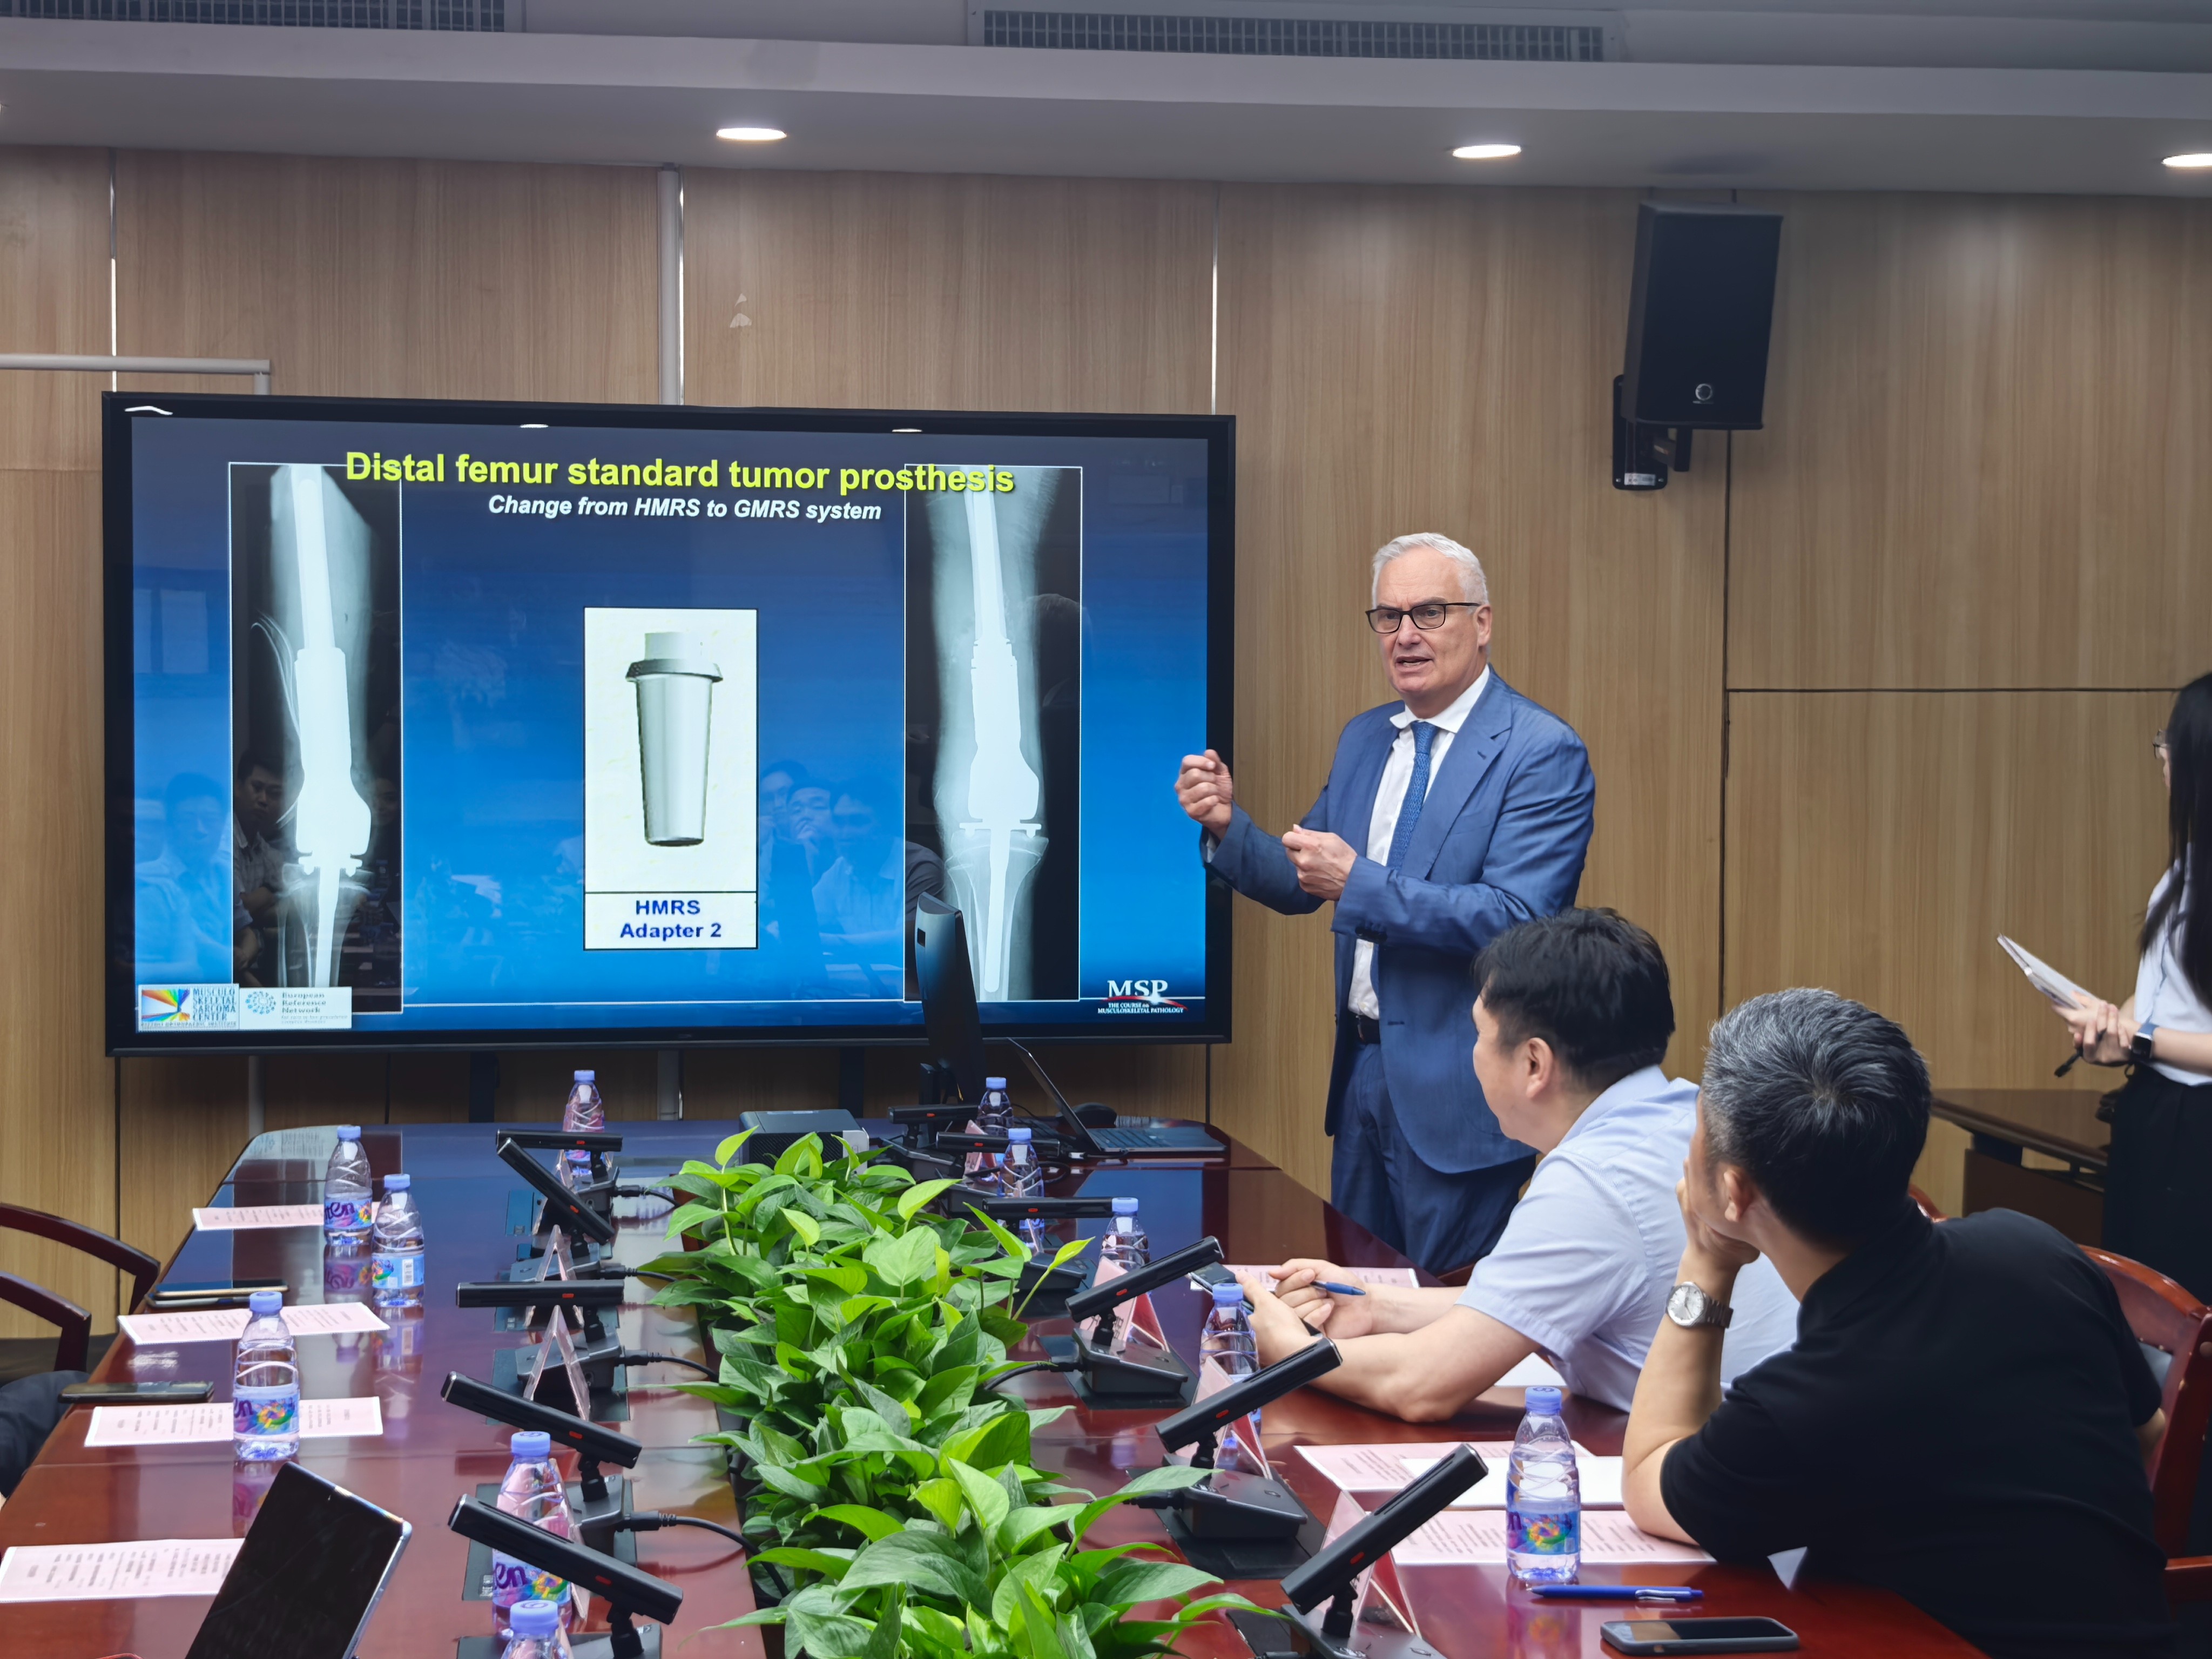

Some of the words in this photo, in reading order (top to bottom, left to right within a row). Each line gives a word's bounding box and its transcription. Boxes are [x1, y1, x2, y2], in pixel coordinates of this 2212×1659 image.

[346, 452, 444, 482] Distal
[456, 454, 558, 484] femur
[568, 457, 718, 487] standard
[729, 461, 831, 489] tumor
[840, 464, 1014, 496] prosthesis
[488, 495, 572, 518] Change
[577, 497, 628, 516] from
[634, 498, 701, 517] HMRS
[707, 500, 727, 517] to
[734, 500, 800, 518] GMRS
[805, 503, 882, 523] system
[636, 900, 700, 915] HMRS
[620, 922, 704, 941] Adapter
[710, 922, 722, 937] 2
[1107, 980, 1169, 998] MSP
